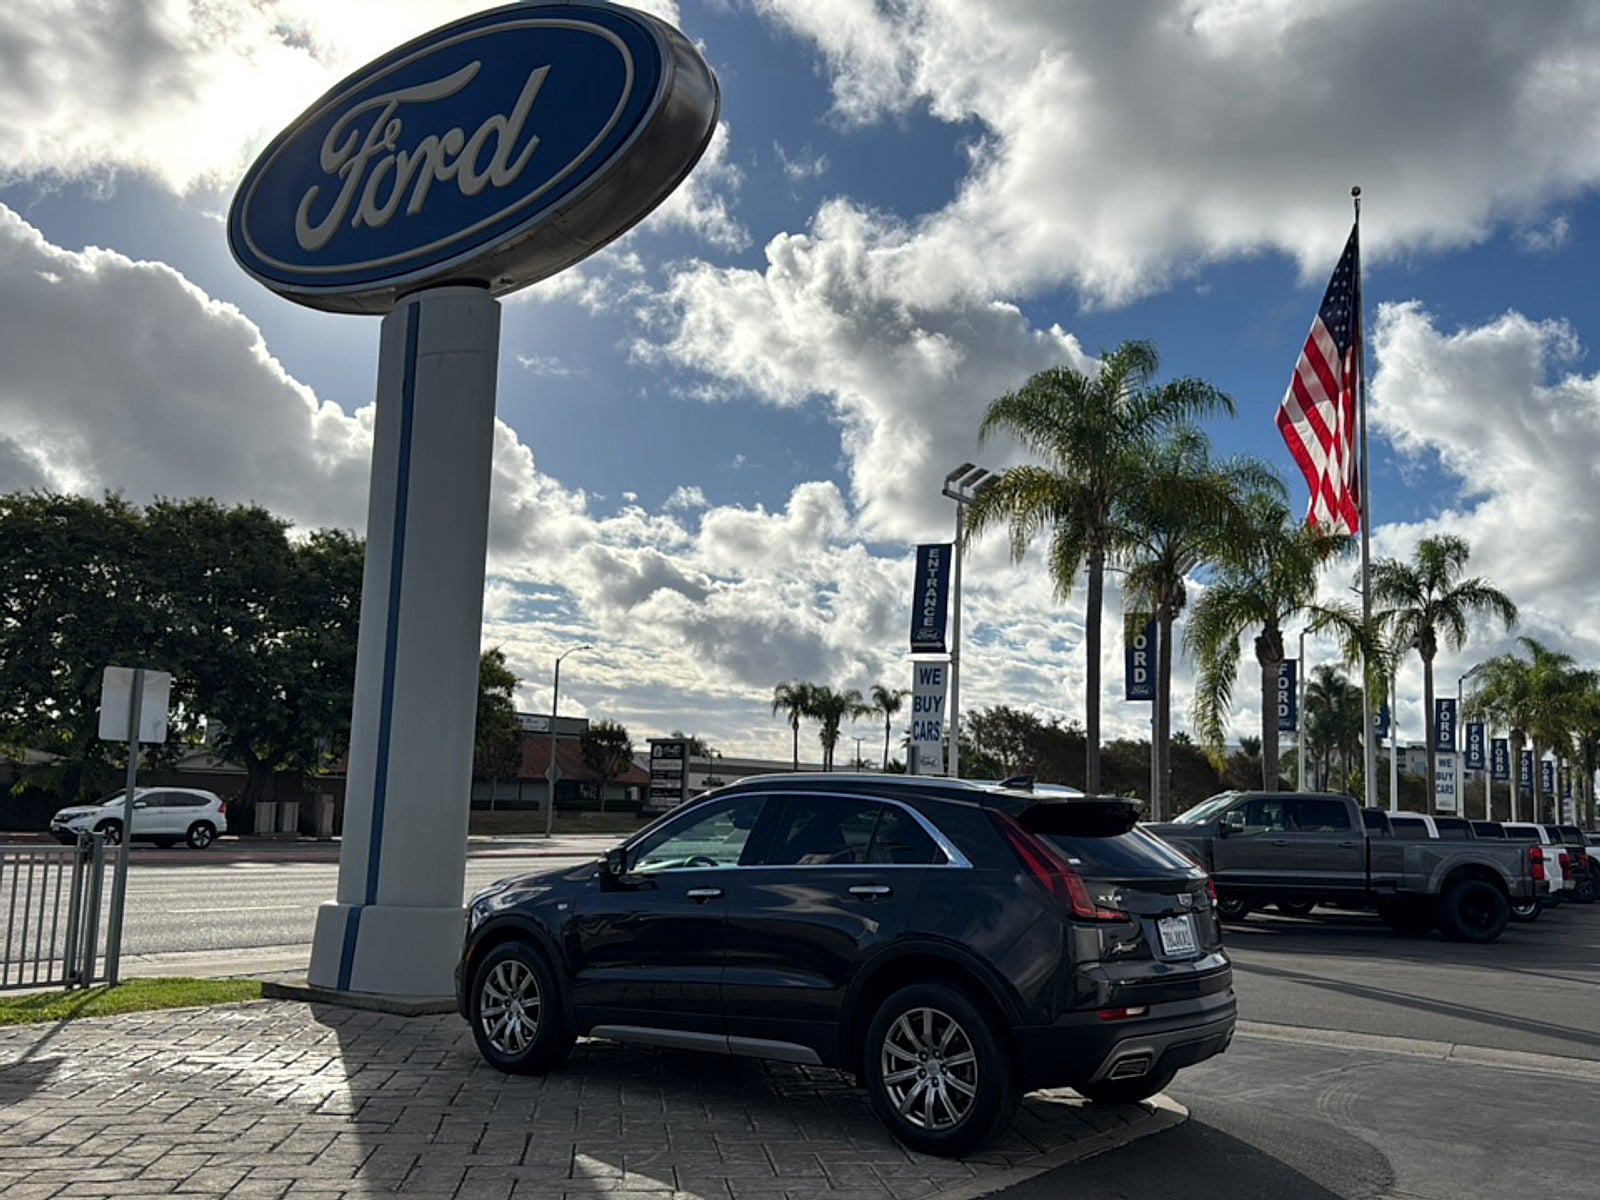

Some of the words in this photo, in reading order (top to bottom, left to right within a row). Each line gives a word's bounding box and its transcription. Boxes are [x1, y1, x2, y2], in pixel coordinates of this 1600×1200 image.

[295, 60, 551, 251] Ford
[923, 548, 940, 627] ENTRANCE
[920, 668, 941, 685] WE
[1278, 664, 1289, 717] FORD
[914, 696, 942, 712] BUY
[913, 721, 940, 741] CARS
[1440, 701, 1450, 741] FORD
[1470, 725, 1480, 761] FORD
[1495, 740, 1504, 772] FORD
[1436, 771, 1453, 780] BUY
[1439, 759, 1452, 768] WE
[1436, 784, 1454, 794] CARS
